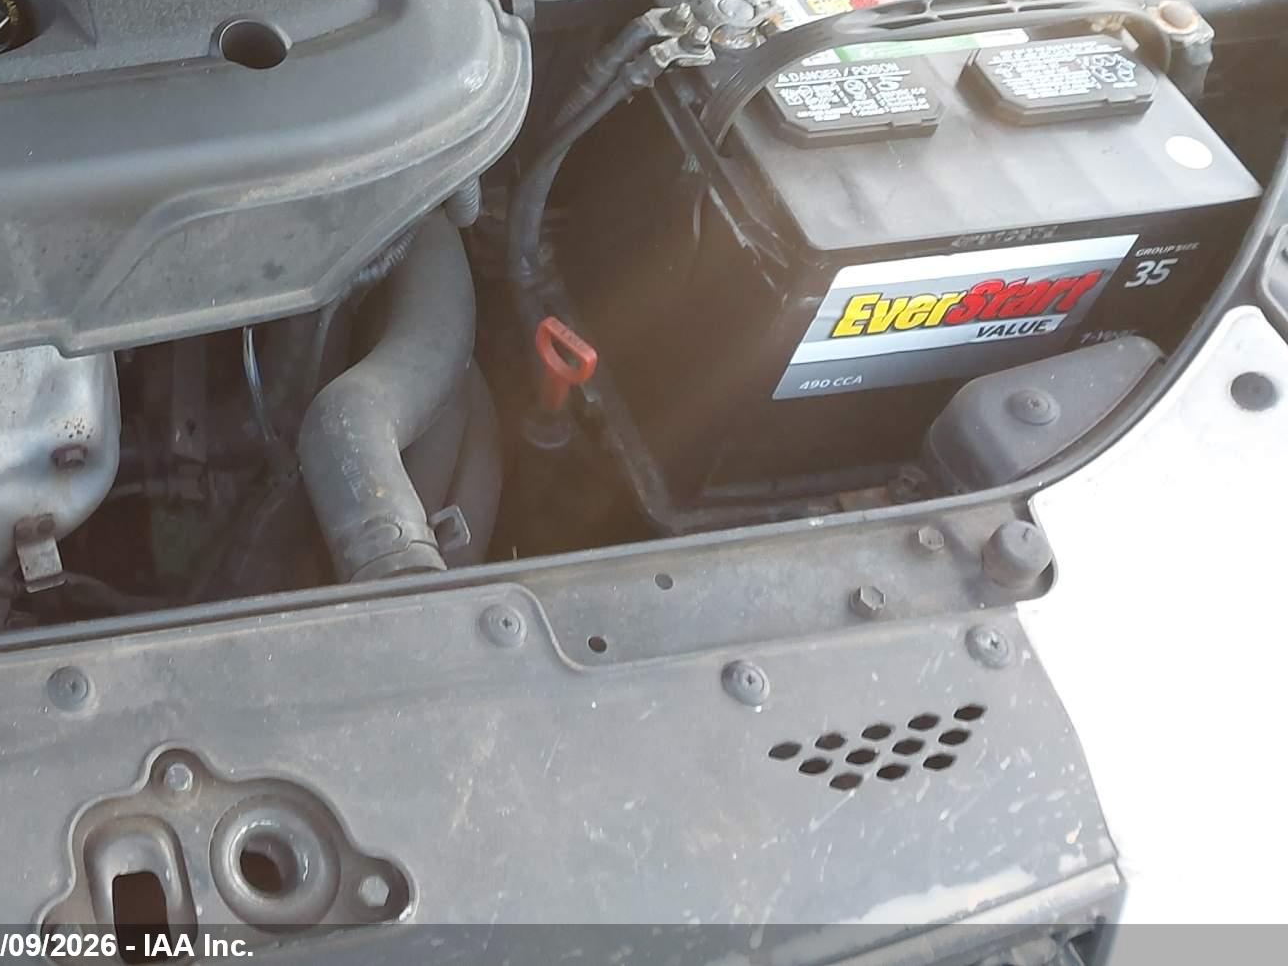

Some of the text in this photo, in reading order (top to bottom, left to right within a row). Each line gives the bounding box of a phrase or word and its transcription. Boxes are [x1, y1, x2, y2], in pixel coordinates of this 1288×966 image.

[789, 68, 842, 83] DANGER
[851, 62, 900, 76] POISON
[1135, 245, 1174, 257] GROUP
[1124, 258, 1180, 289] 35
[831, 269, 1104, 339] EverStart
[976, 319, 1051, 340] VALUE
[799, 374, 864, 391] 490 CCA
